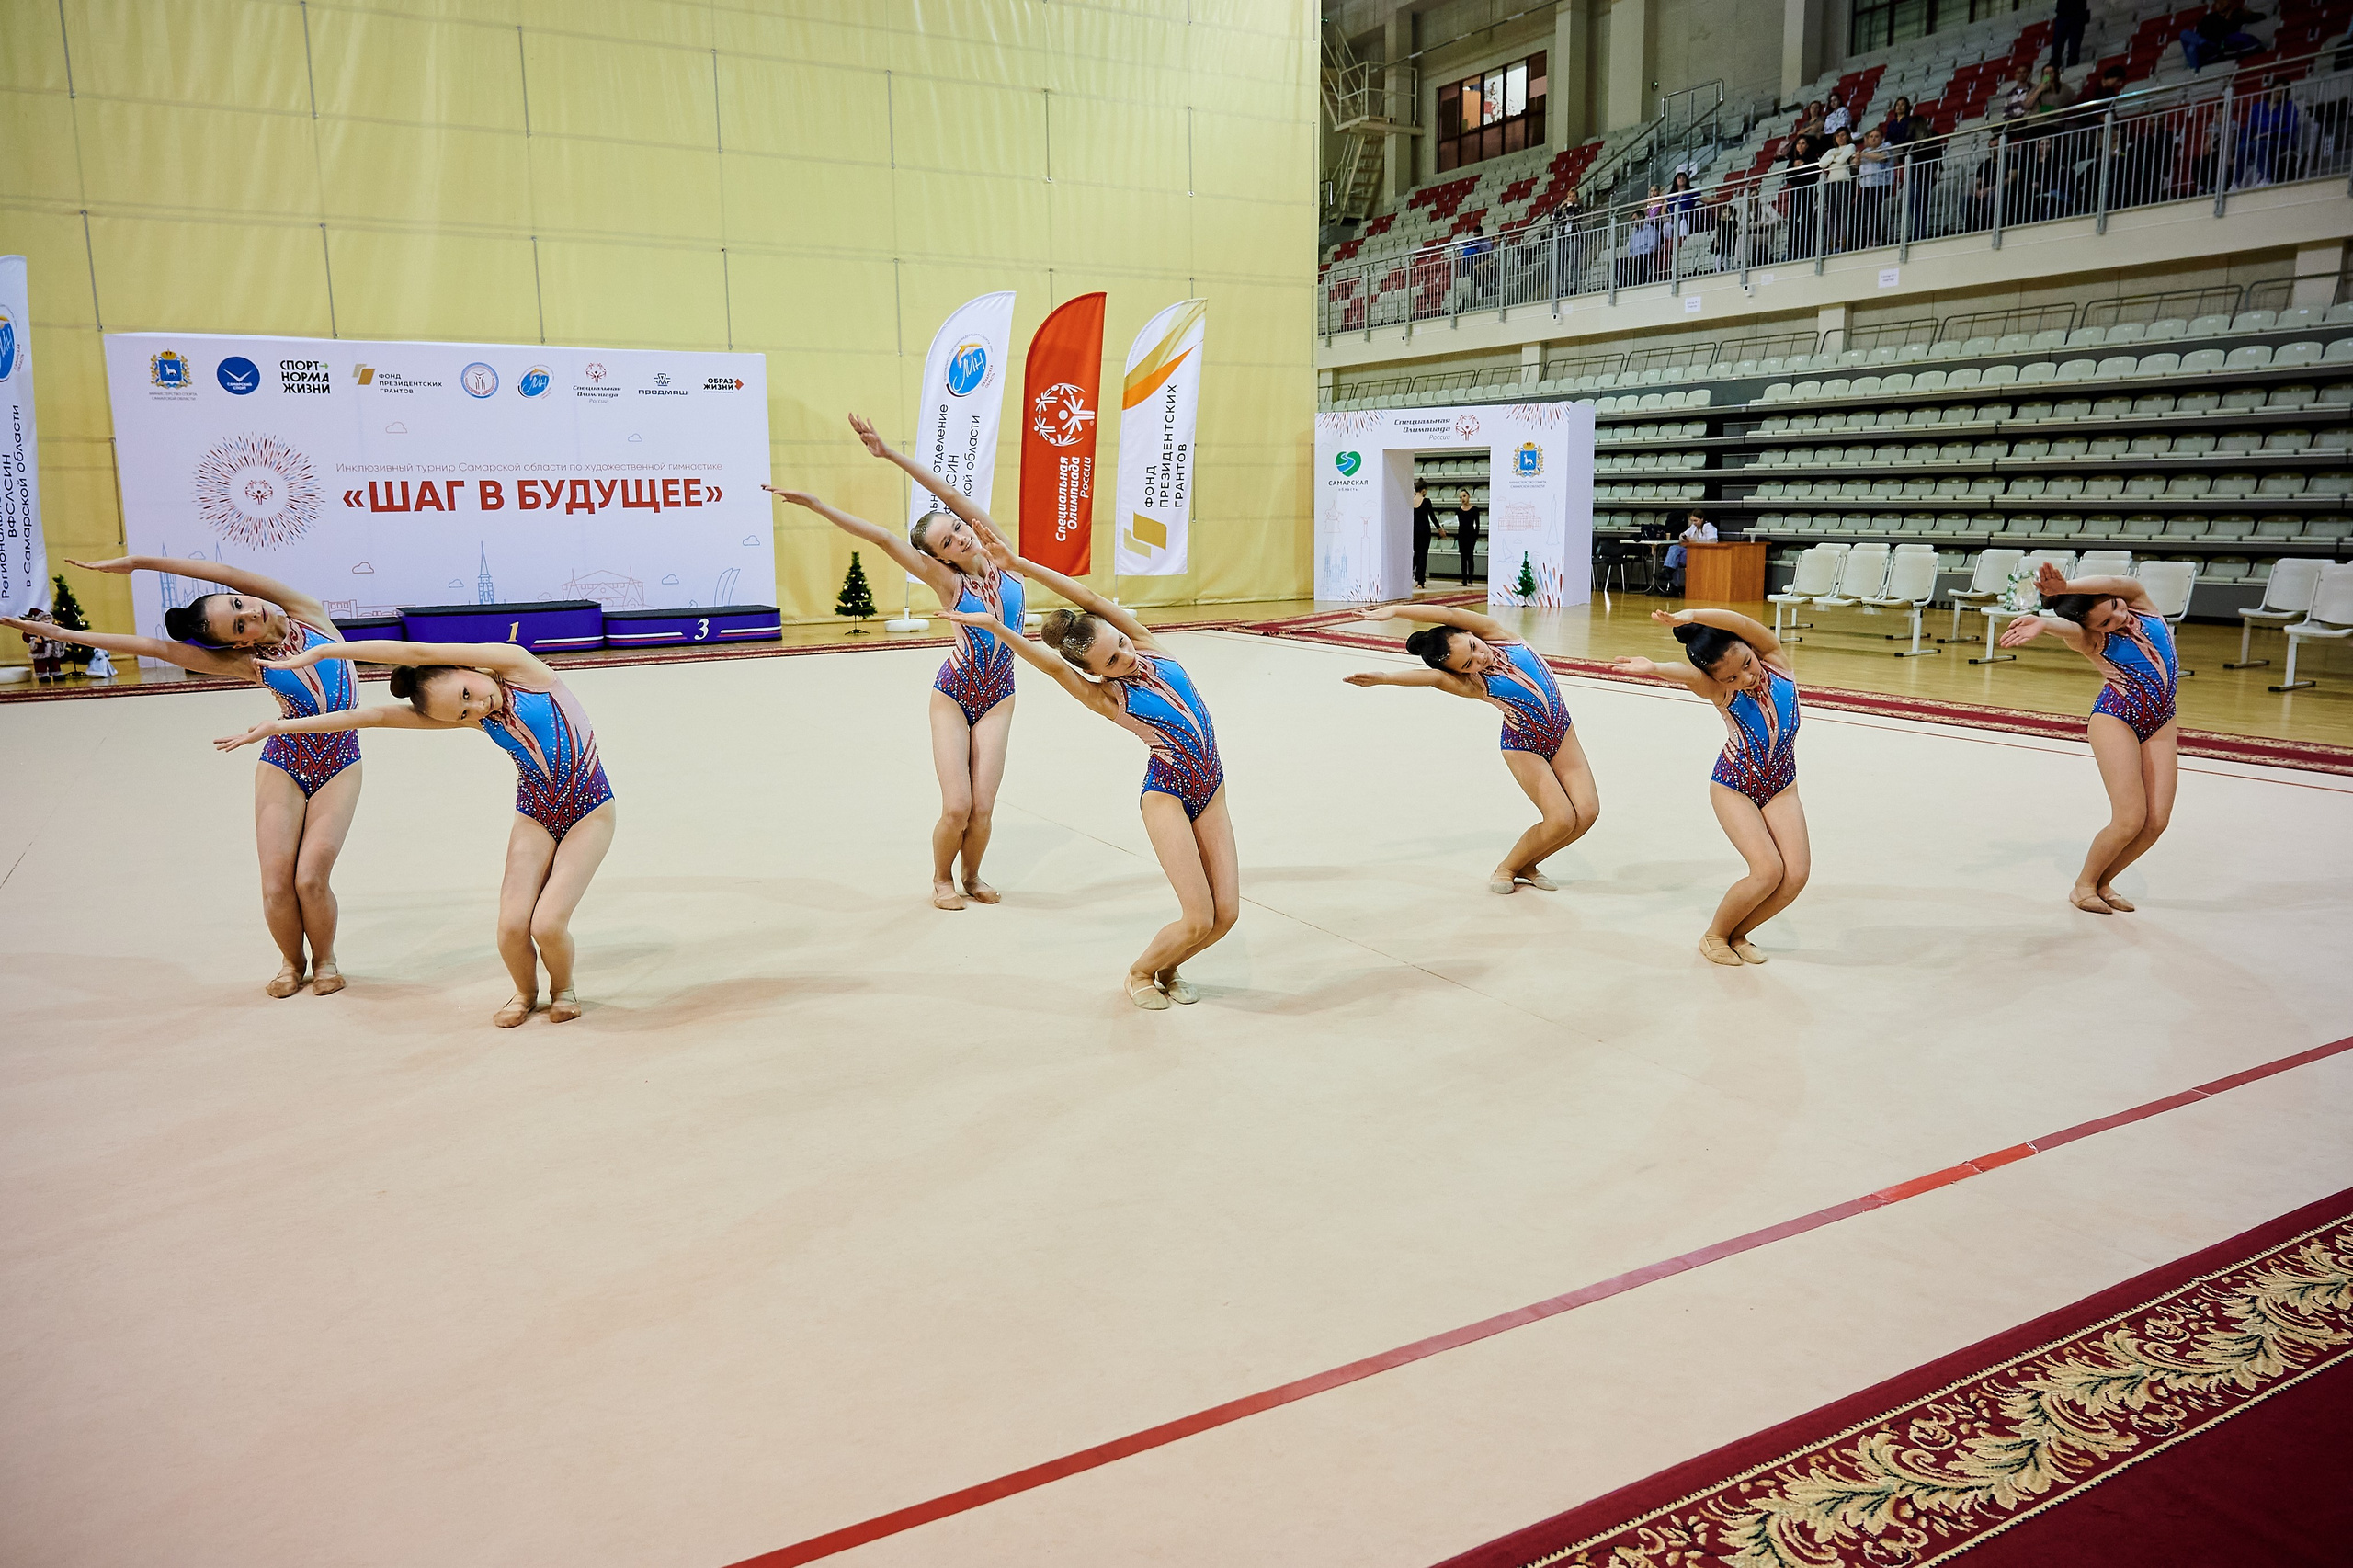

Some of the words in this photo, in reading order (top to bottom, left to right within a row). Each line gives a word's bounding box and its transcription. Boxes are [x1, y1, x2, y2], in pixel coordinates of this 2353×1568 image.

[279, 360, 319, 370] СПОРТ
[281, 371, 330, 382] НОРМА
[283, 383, 331, 394] ЖИЗНИ
[13, 405, 26, 472] области
[933, 404, 949, 473] отделение
[964, 415, 980, 470] области
[1159, 384, 1177, 508] ПРЕЗИДЕНТСКИХ
[336, 463, 413, 472] Инклюзивный
[416, 464, 456, 473] турнир
[458, 462, 521, 472] Самарской
[524, 462, 567, 472] области
[585, 463, 666, 472] художественной
[668, 463, 722, 472] гимнастике
[1079, 456, 1091, 499] России
[1144, 465, 1157, 508] ФОНД
[1174, 443, 1188, 508] ГРАНТОВ
[2, 454, 17, 538] ВФСЛСИН
[343, 480, 465, 513] «ШАГ
[479, 480, 505, 511] В
[517, 478, 723, 515] БУДУЩЕЕ»
[1055, 456, 1069, 542] Специальная
[1067, 456, 1080, 530] Олимпиада
[17, 478, 32, 574] Самарской
[507, 621, 519, 642] 1
[694, 618, 709, 641] 3
